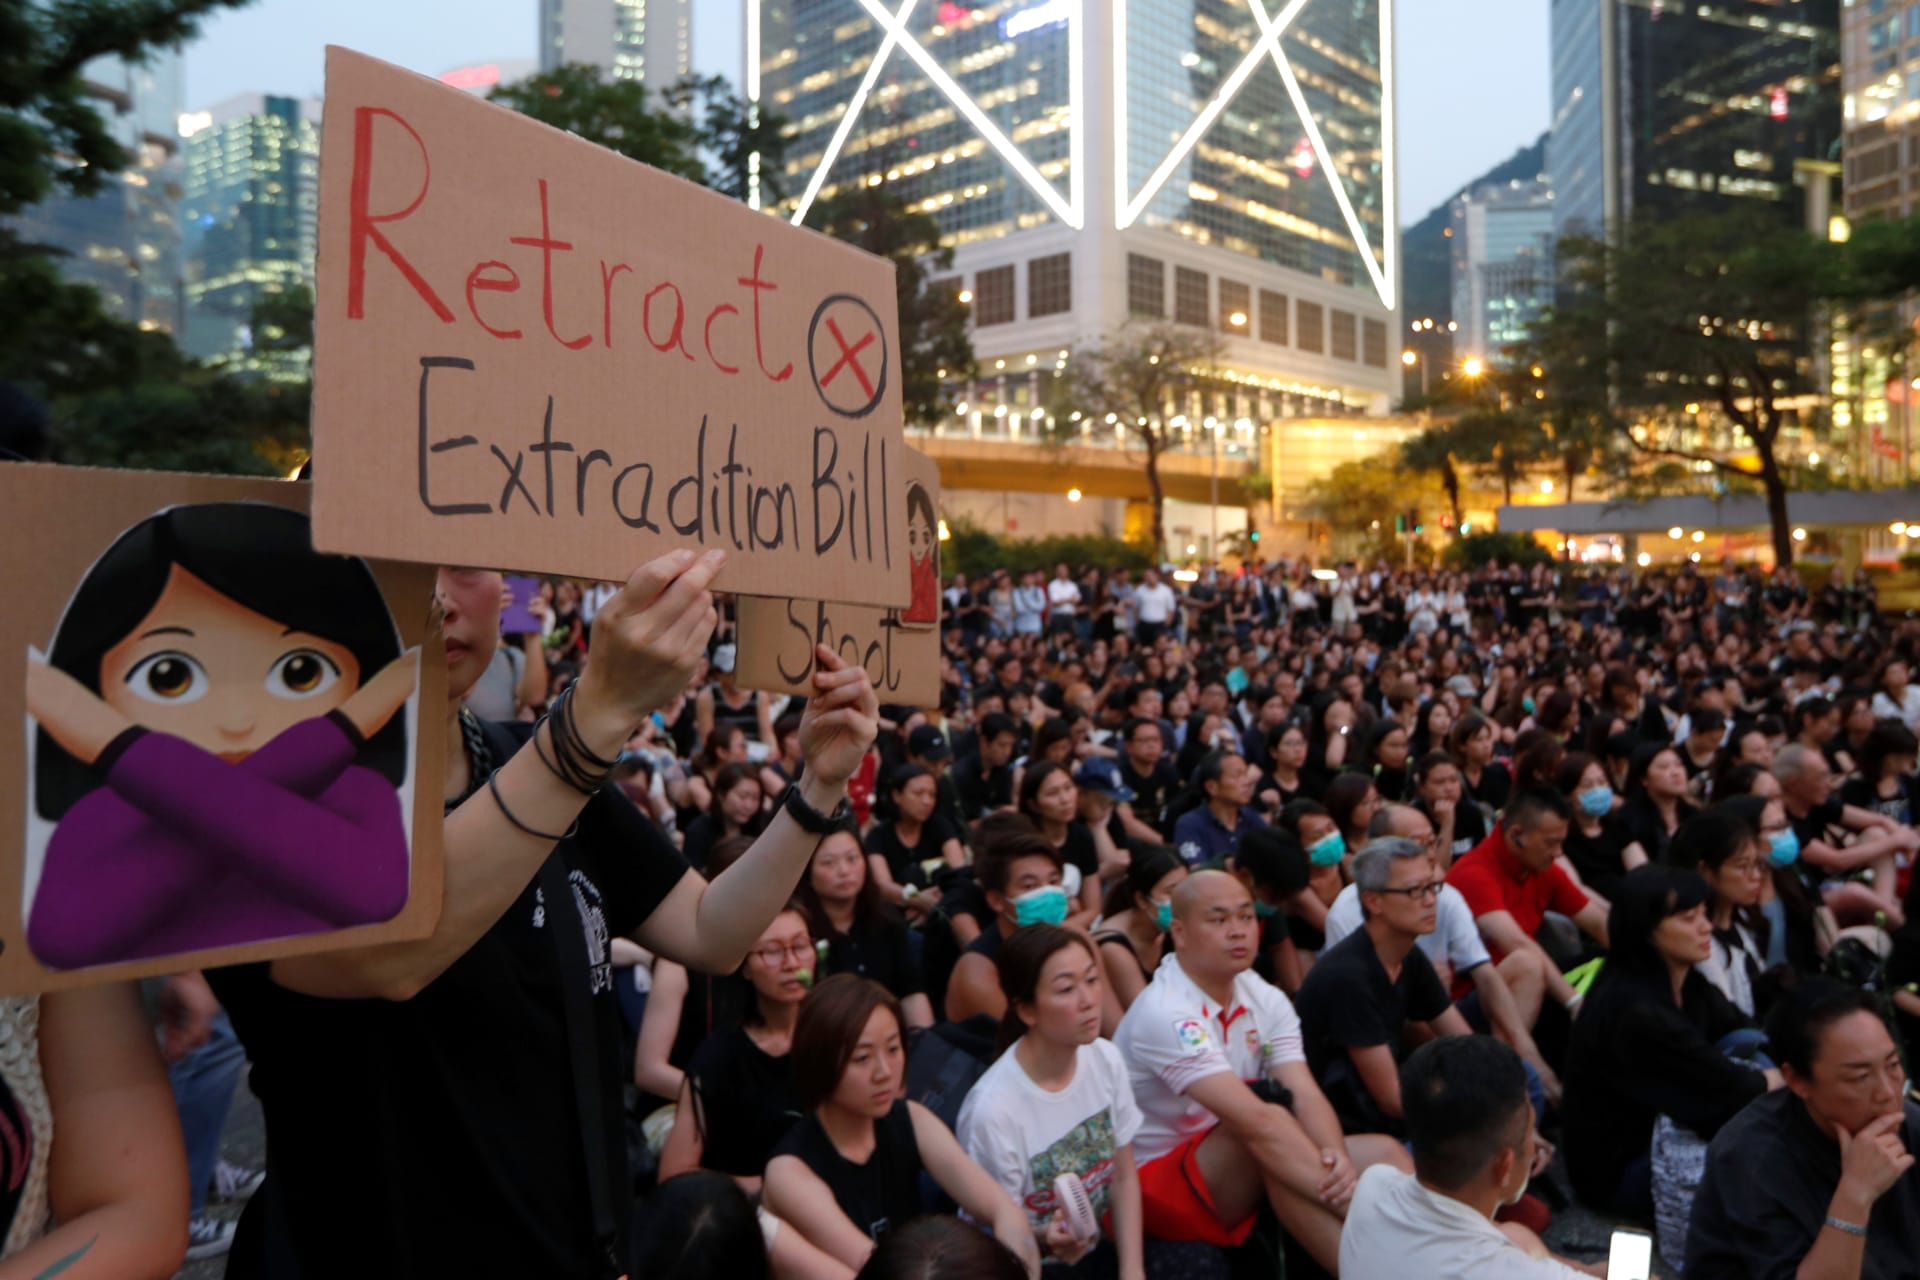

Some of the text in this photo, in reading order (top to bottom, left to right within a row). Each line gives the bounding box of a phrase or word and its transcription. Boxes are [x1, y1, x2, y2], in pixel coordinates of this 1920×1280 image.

[347, 106, 793, 381] Retract
[418, 356, 891, 571] Extradition Bill
